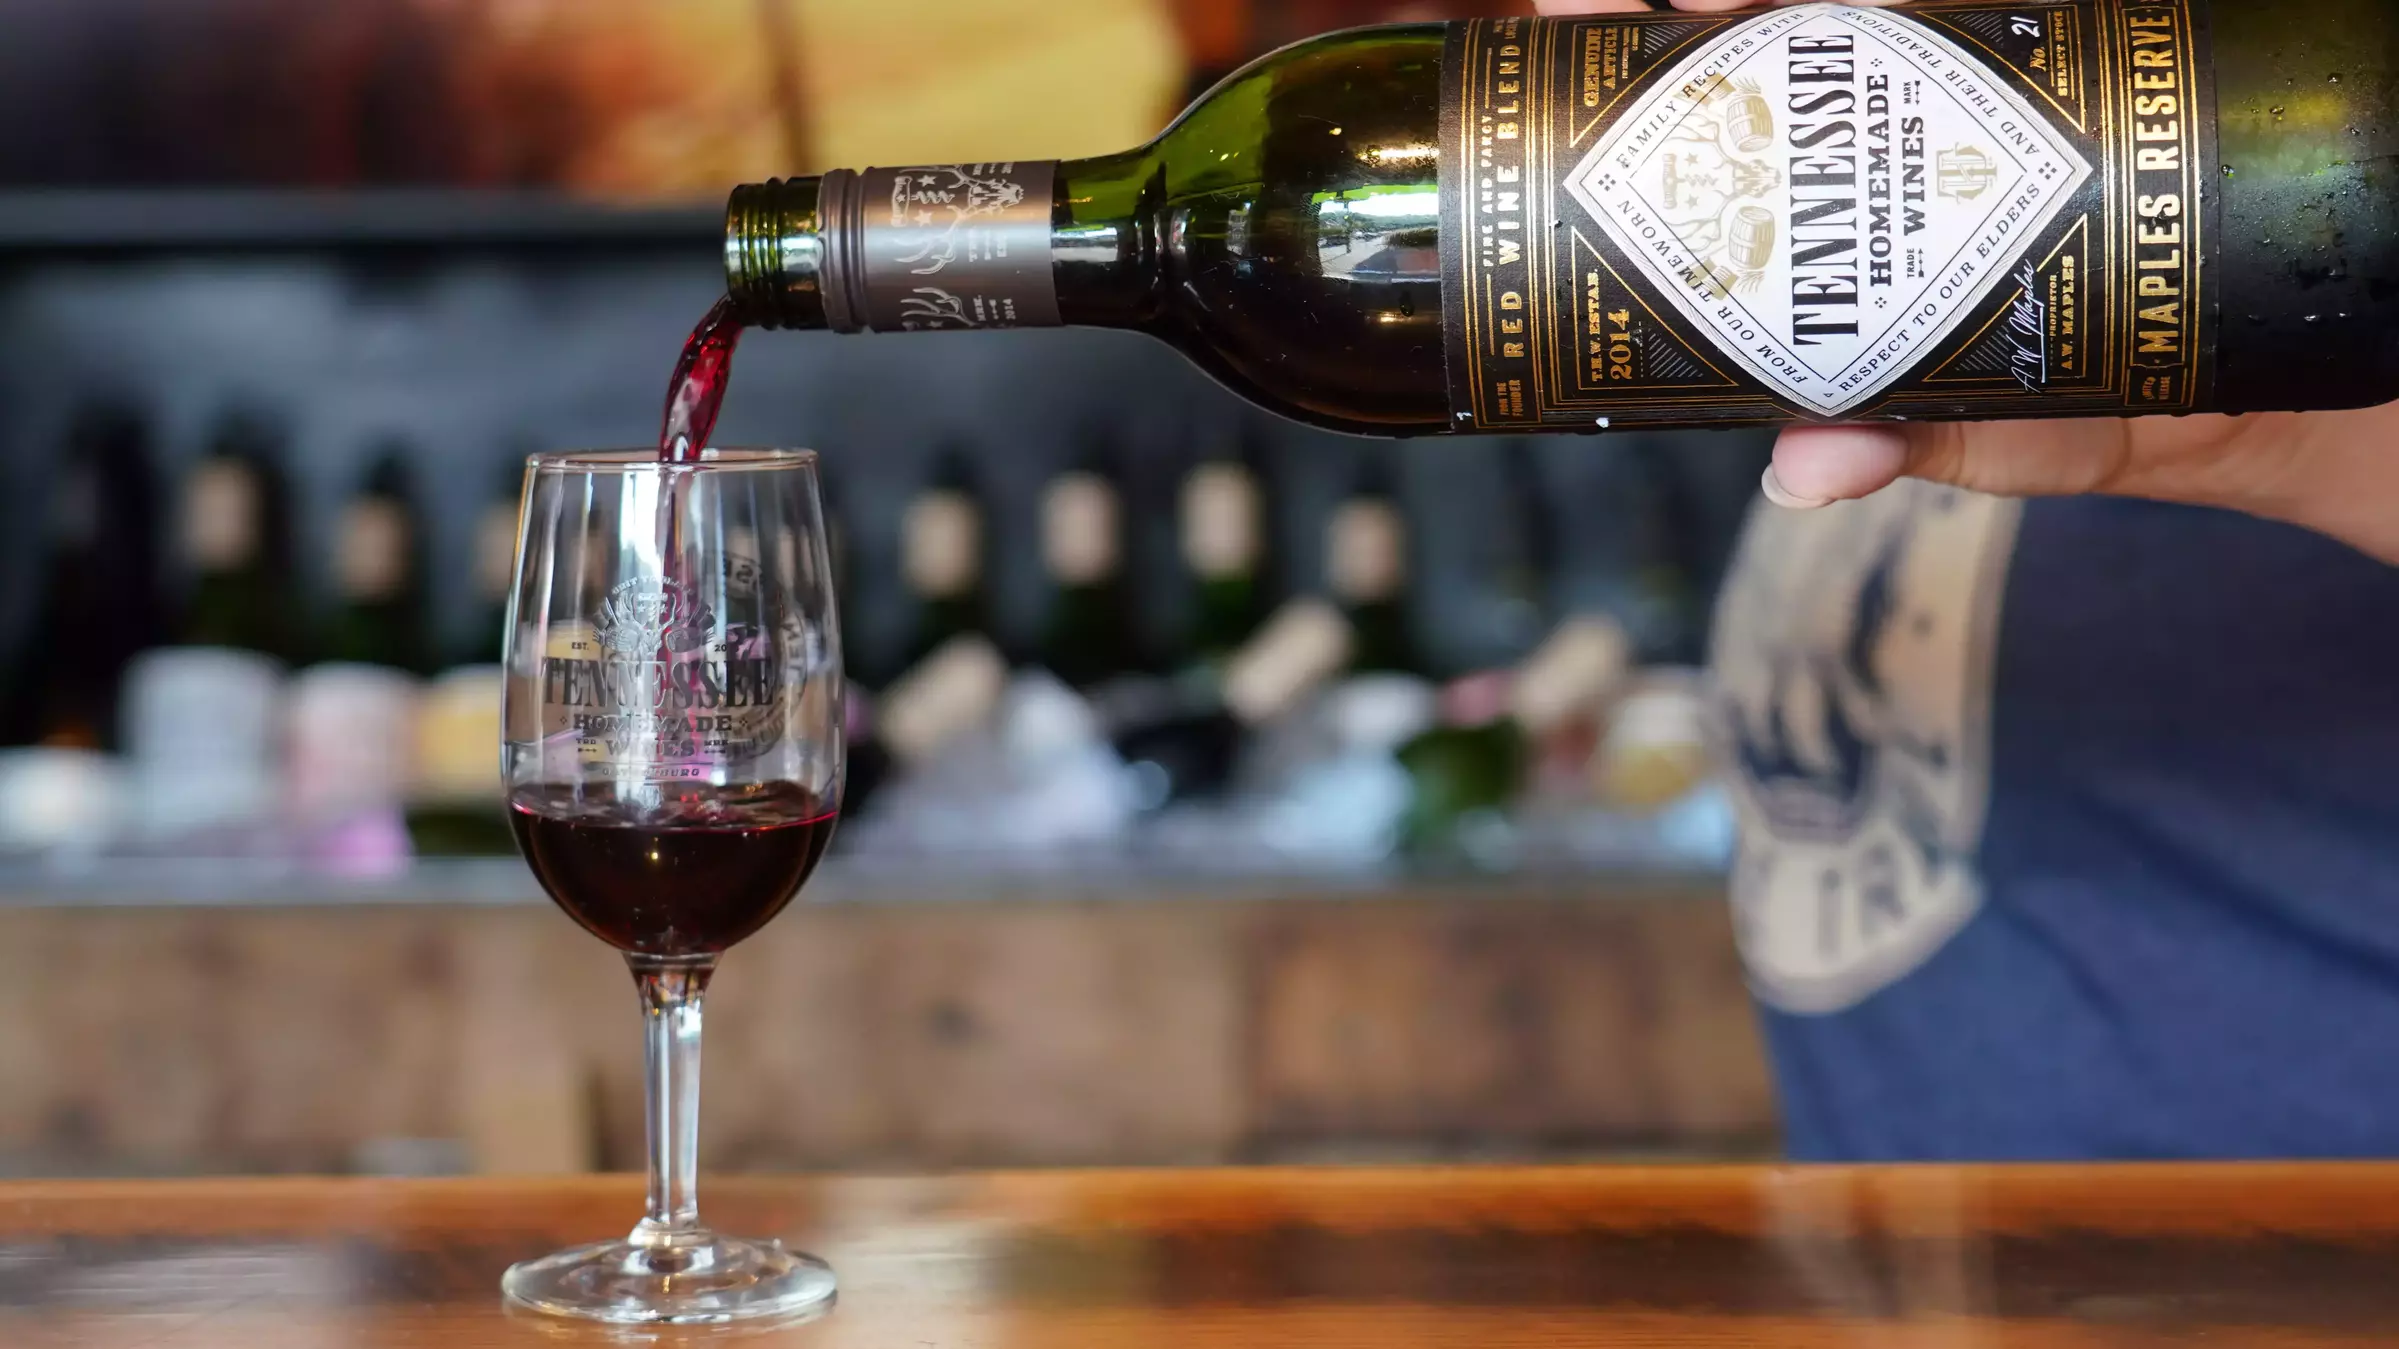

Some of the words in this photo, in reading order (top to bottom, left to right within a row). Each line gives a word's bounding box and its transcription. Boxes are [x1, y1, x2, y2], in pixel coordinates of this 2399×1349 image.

[1603, 28, 1617, 89] ARTICLE
[1841, 10, 1942, 68] TRADITIONS
[2010, 15, 2041, 38] 21
[1498, 44, 1521, 139] BLEND
[1584, 28, 1602, 107] GENUINE
[1616, 99, 1680, 168] FAMILY
[1682, 37, 1755, 98] RECIPES
[1758, 13, 1803, 36] WITH
[1903, 81, 1911, 104] MARK
[1946, 69, 1998, 117] THEIR
[2056, 44, 2069, 97] SELECT
[2130, 15, 2180, 171] RESERVE
[1481, 115, 1493, 167] FANCY
[2002, 121, 2040, 154] AND
[1481, 187, 1493, 213] AND
[1788, 34, 1858, 346] TENNESSEE
[1867, 73, 1892, 288] HOMEMADE
[1902, 116, 1925, 236] WINES
[1481, 224, 1494, 267] FINE
[1497, 165, 1520, 265] WINE
[1617, 201, 1714, 304] TIMEWORN
[1907, 248, 1915, 279] TRADE
[2138, 194, 2180, 354] MAPLES
[1840, 332, 1910, 392] RESPECT
[1913, 302, 1938, 327] TO
[1939, 261, 1976, 300] OUR
[1979, 183, 2040, 259] ELDERS
[2061, 255, 2075, 335] MAPLES
[1502, 291, 1525, 358] RED
[1607, 309, 1632, 380] 2014
[1717, 305, 1756, 341] OUR
[1756, 344, 1808, 384] FROM
[571, 642, 590, 650] EST.
